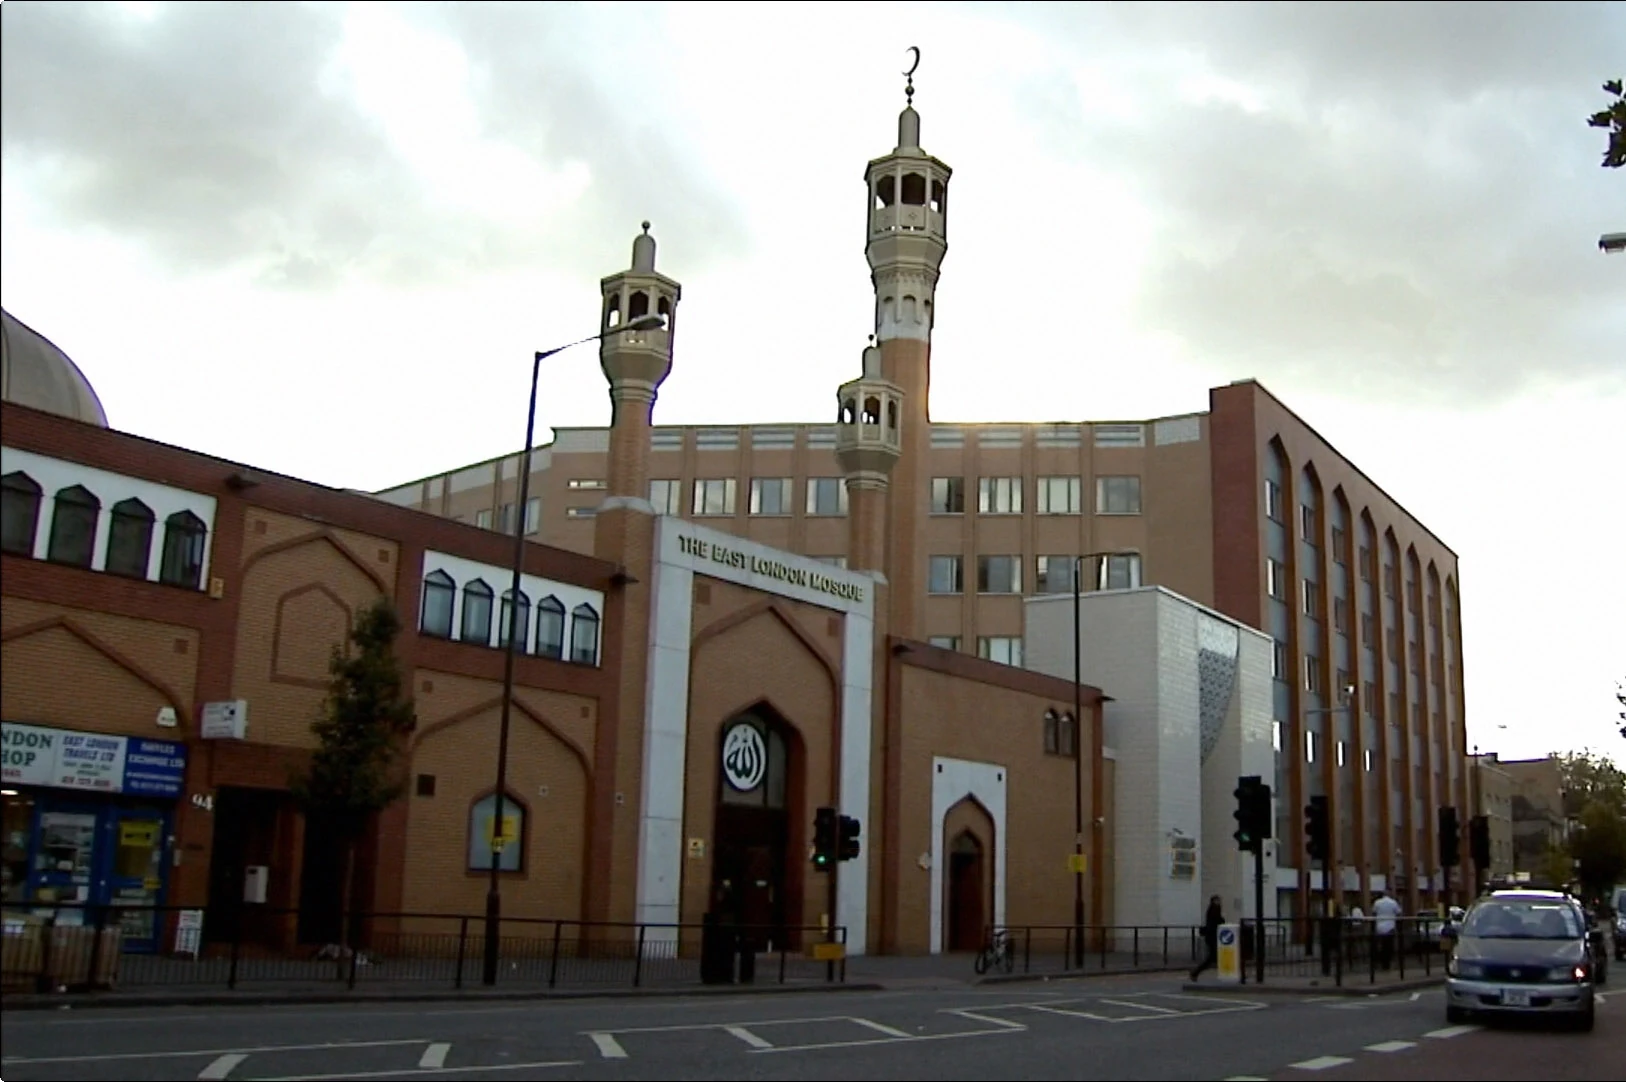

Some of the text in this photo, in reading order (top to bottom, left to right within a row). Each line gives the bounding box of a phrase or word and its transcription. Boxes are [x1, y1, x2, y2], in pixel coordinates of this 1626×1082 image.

[678, 535, 864, 602] THE EAST LONDON MOSQUE
[192, 793, 214, 812] 94
